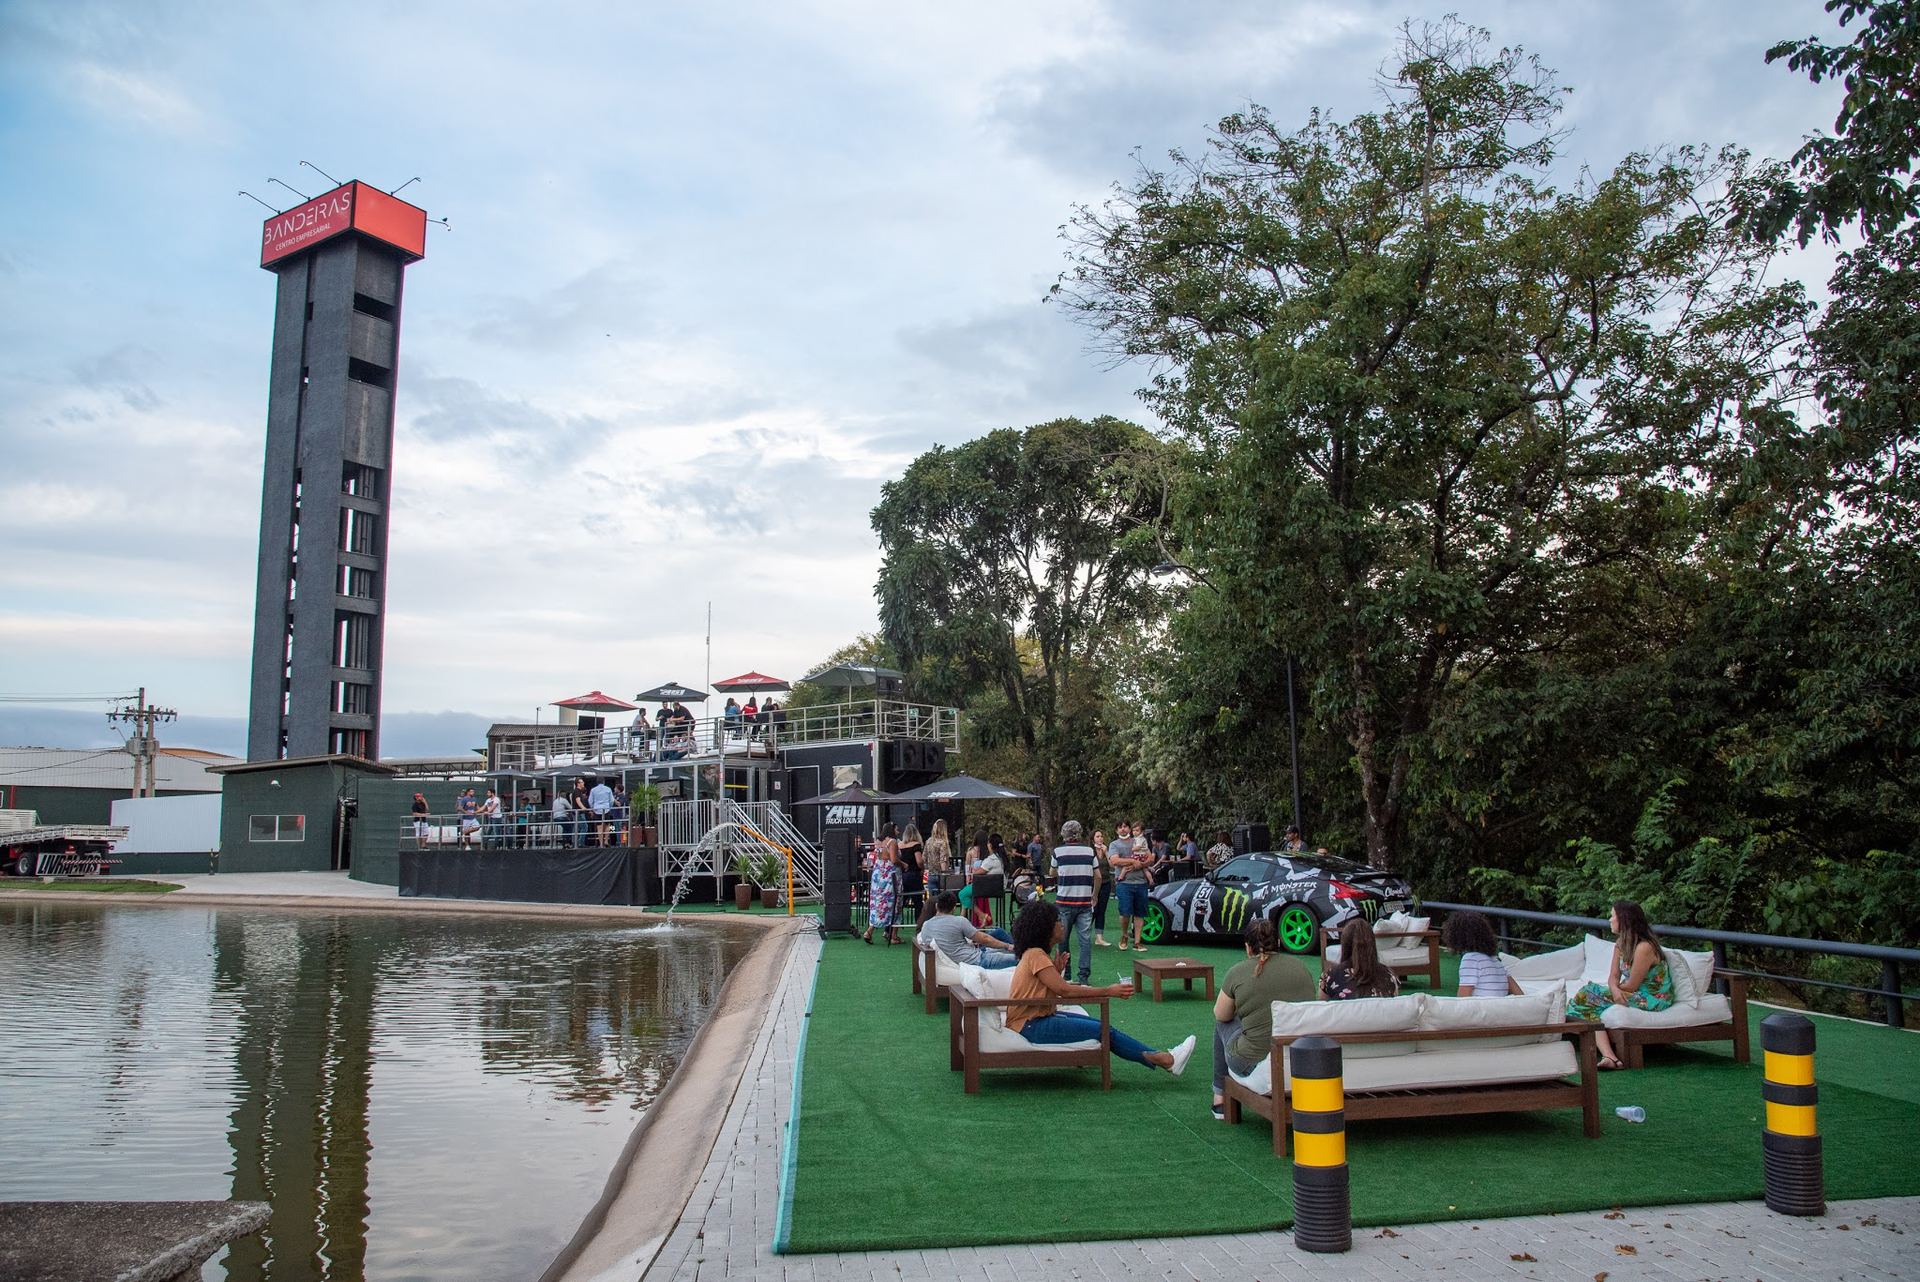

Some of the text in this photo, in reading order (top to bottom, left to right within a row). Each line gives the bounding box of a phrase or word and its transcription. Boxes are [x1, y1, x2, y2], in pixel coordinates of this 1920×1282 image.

[264, 192, 350, 245] BANDEIRAS
[275, 223, 330, 251] CENTRO EMPRESARIAL
[825, 817, 842, 825] TRUCK
[1198, 887, 1211, 899] 51
[1271, 881, 1317, 893] MONSTER
